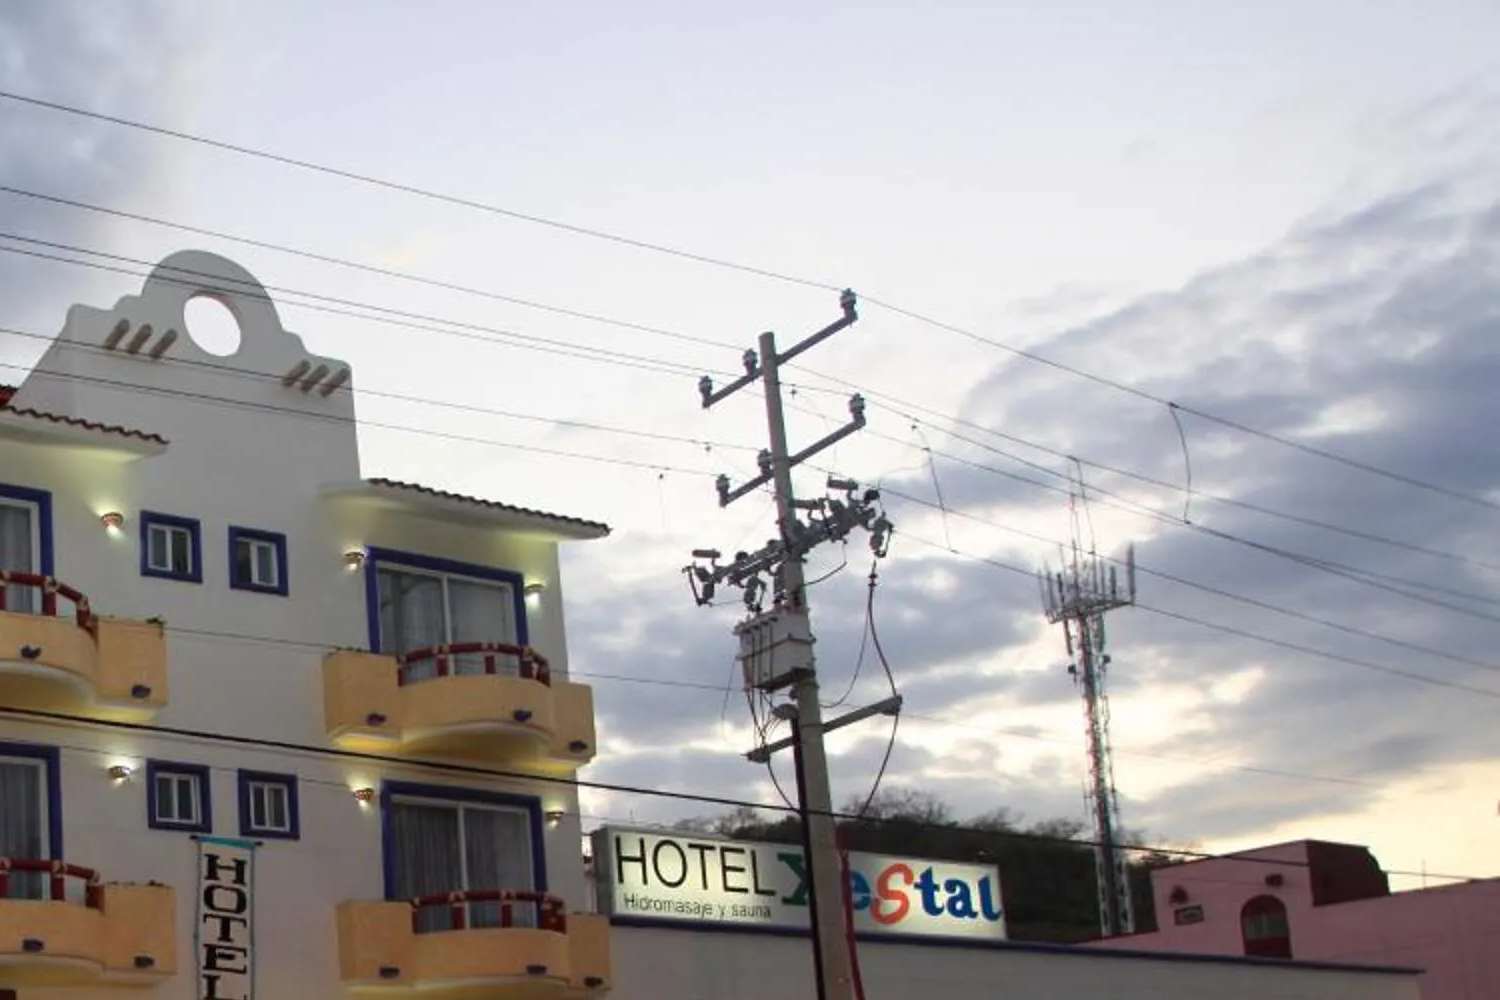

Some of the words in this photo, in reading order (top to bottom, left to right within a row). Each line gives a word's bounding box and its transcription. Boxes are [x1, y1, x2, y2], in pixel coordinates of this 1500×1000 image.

[615, 835, 777, 896] HOTEL
[624, 892, 713, 916] Hidromasaje
[718, 903, 727, 918] y
[731, 903, 772, 918] sauna
